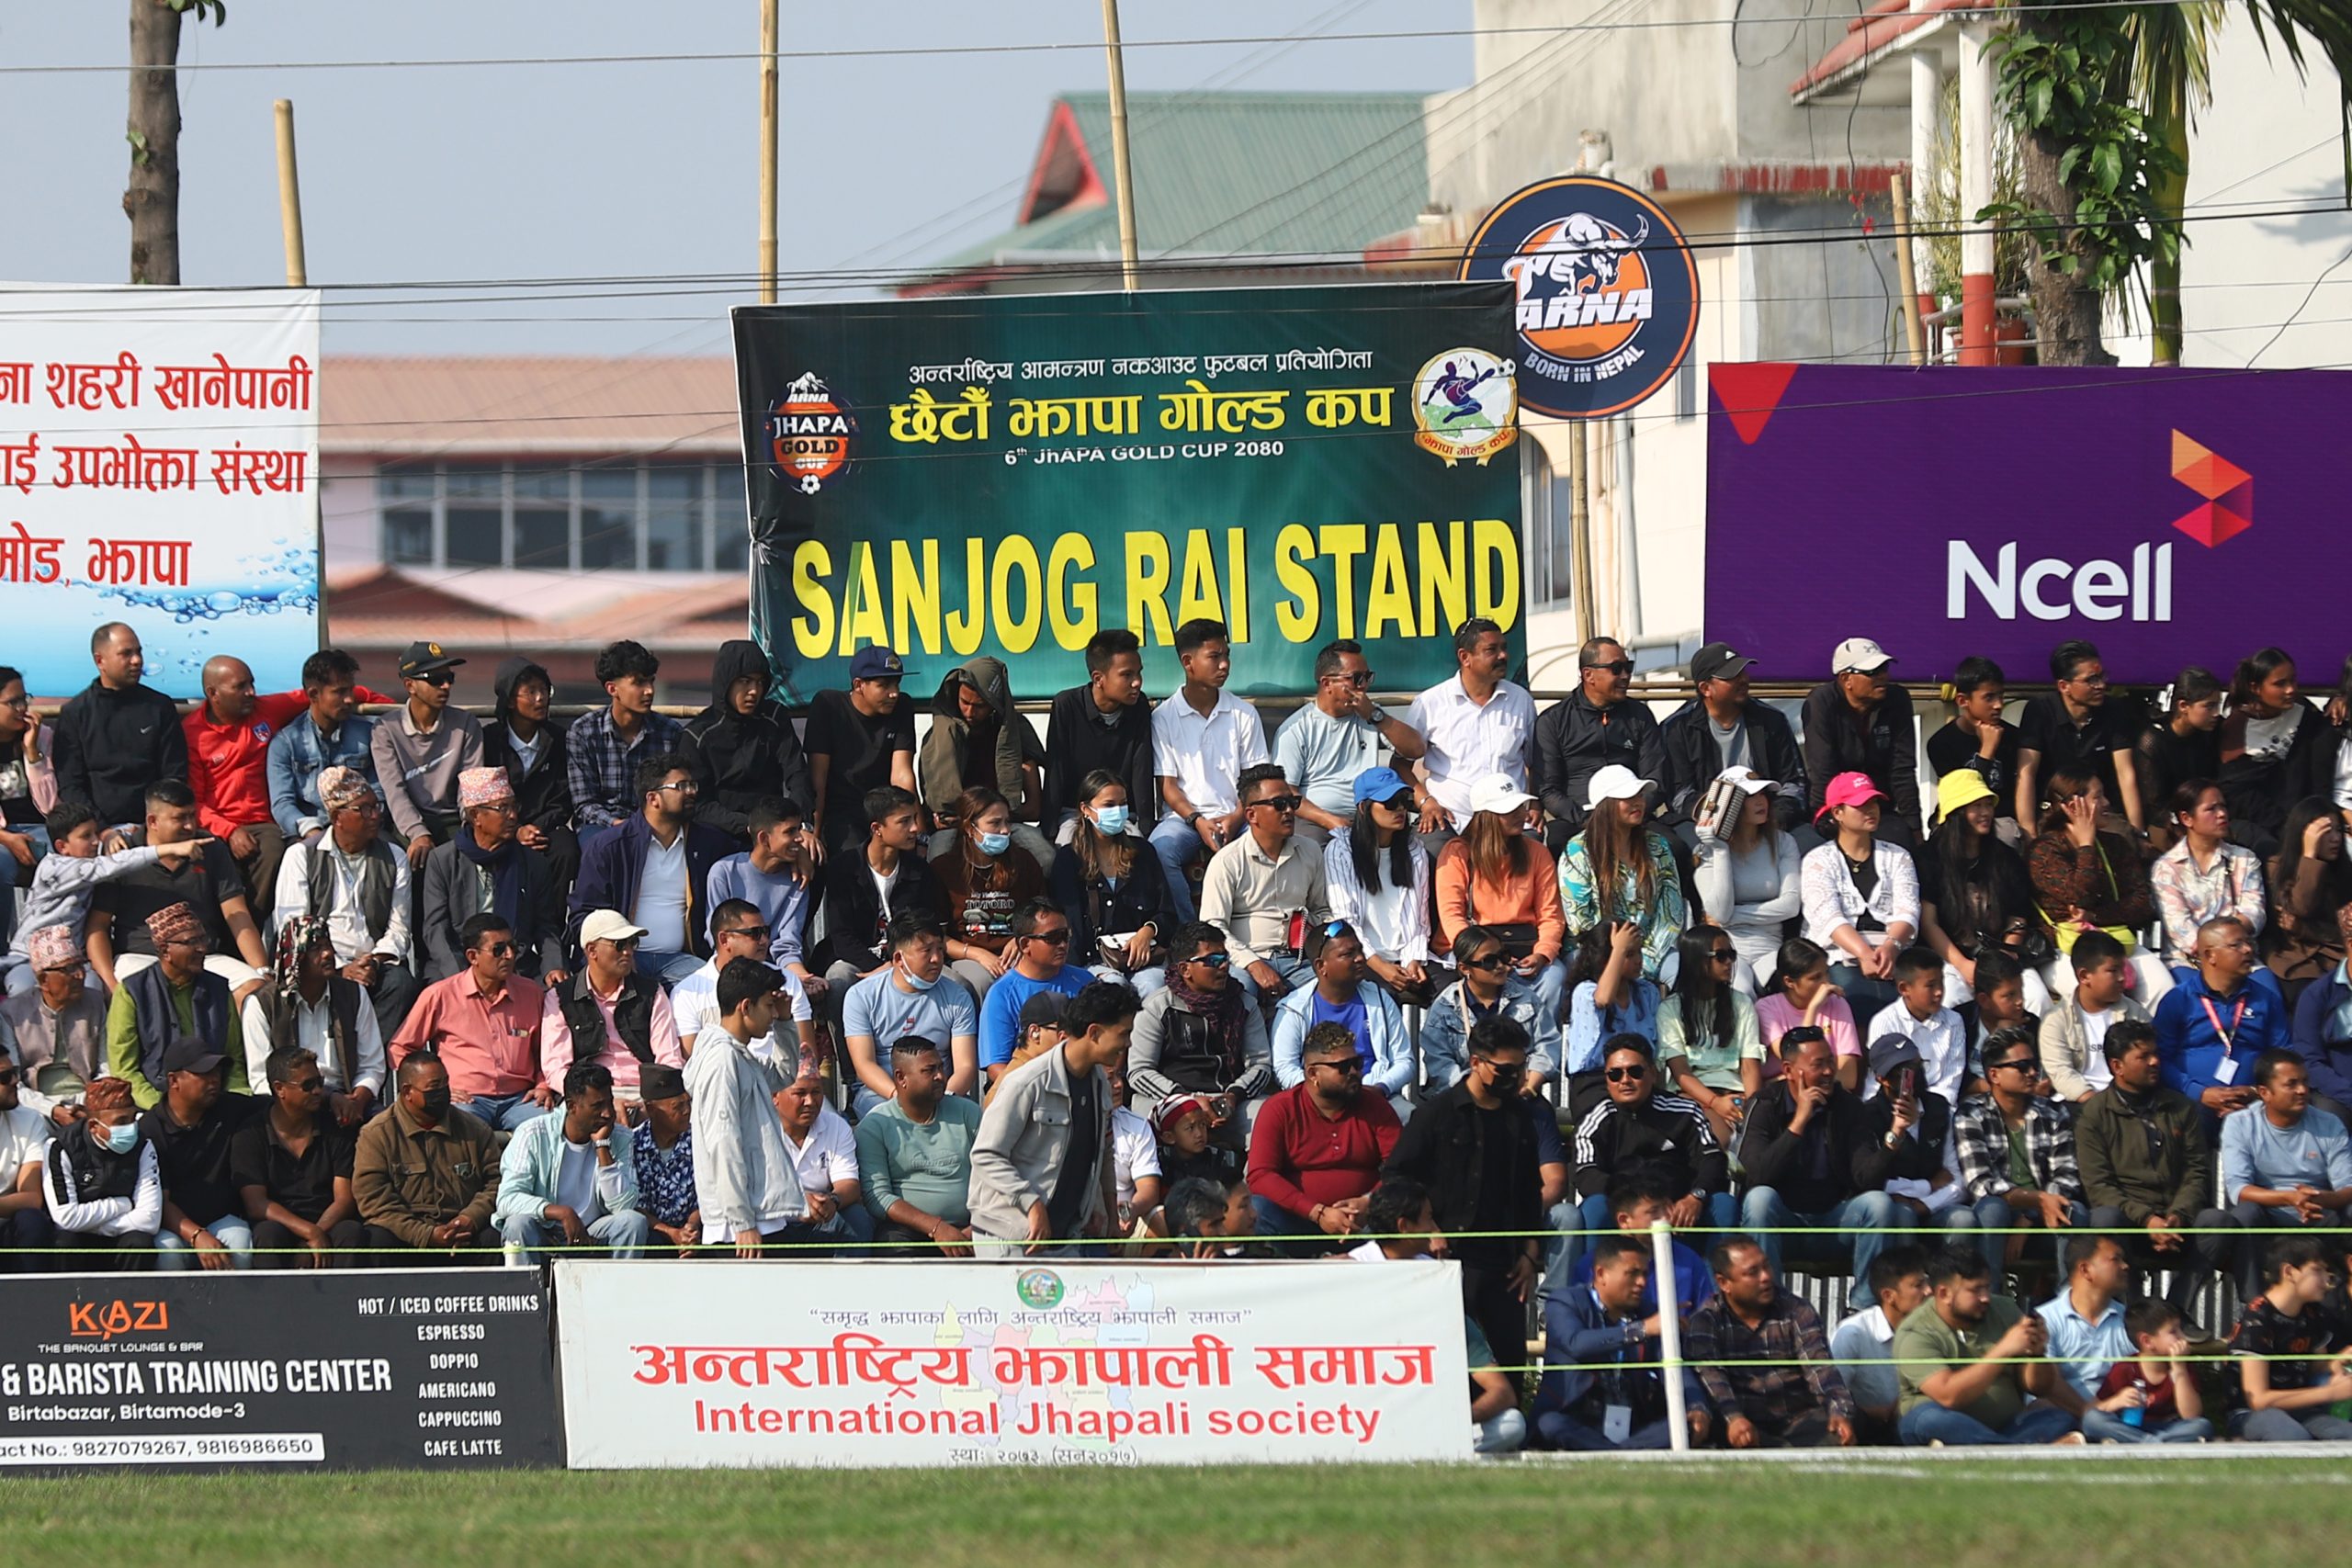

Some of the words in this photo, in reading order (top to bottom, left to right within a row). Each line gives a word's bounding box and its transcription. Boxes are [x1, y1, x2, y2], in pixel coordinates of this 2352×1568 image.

[1516, 288, 1653, 331] ARNA
[1021, 358, 1105, 379] आमन्त्रण
[1111, 355, 1198, 376] नकआउट
[1204, 355, 1269, 378] फुटबल
[1275, 346, 1374, 373] प्रतियोगिता
[1523, 352, 1570, 383] BORN
[1574, 367, 1592, 383] IN
[1594, 344, 1645, 381] NEPAL
[46, 350, 142, 411] शहरी
[154, 353, 313, 411] खानेपानी
[786, 393, 829, 403] ARNA
[1009, 395, 1143, 437] झापा
[1158, 379, 1290, 433] गोल्ड
[1306, 387, 1396, 428] कप
[774, 415, 849, 439] JHAPA
[781, 440, 840, 455] GOLD
[1111, 445, 1175, 461] GOLD
[1181, 443, 1228, 458] CUP
[1234, 441, 1284, 457] 2080
[51, 433, 199, 493] उपभोक्ता
[210, 441, 308, 495] संस्था
[795, 457, 829, 469] CUP
[87, 538, 192, 587] झापा
[791, 531, 1099, 660] SANJOG
[1125, 527, 1249, 647] RAI
[1274, 519, 1521, 644] STAND
[1947, 539, 2173, 622] Ncell
[358, 1297, 385, 1314] HOT
[390, 1297, 396, 1314] /
[400, 1297, 431, 1314] ICED
[435, 1296, 485, 1314] COFFEE
[489, 1295, 539, 1312] DRINKS
[69, 1300, 168, 1338] KAZI
[880, 1311, 945, 1325] झापाका
[956, 1307, 1000, 1325] लागि
[1113, 1307, 1177, 1325] झापाली
[417, 1324, 486, 1341] ESPRESSO
[38, 1344, 60, 1354] THE
[63, 1343, 118, 1354] BANQUET
[120, 1343, 165, 1353] LOUNGE
[169, 1343, 177, 1352] &
[180, 1342, 204, 1352] BAR
[429, 1353, 479, 1370] DOPPIO
[993, 1334, 1234, 1387] झापाली
[1254, 1346, 1437, 1389] समाज
[1, 1363, 21, 1396] &
[27, 1361, 145, 1395] BARISTA
[149, 1359, 278, 1394] TRAINING
[285, 1359, 392, 1393] CENTER
[418, 1382, 496, 1399] AMERICANO
[7, 1404, 116, 1422] Birtabazar,
[119, 1403, 246, 1421] Birtamode-3
[418, 1410, 502, 1427] CAPPUCCINO
[695, 1399, 999, 1435] International
[1017, 1402, 1192, 1443] Jhapali
[1208, 1402, 1382, 1443] society
[73, 1440, 192, 1458] 9827079267,
[197, 1438, 313, 1455] 9816986650
[424, 1440, 458, 1457] CAFE
[461, 1439, 503, 1456] LATTE
